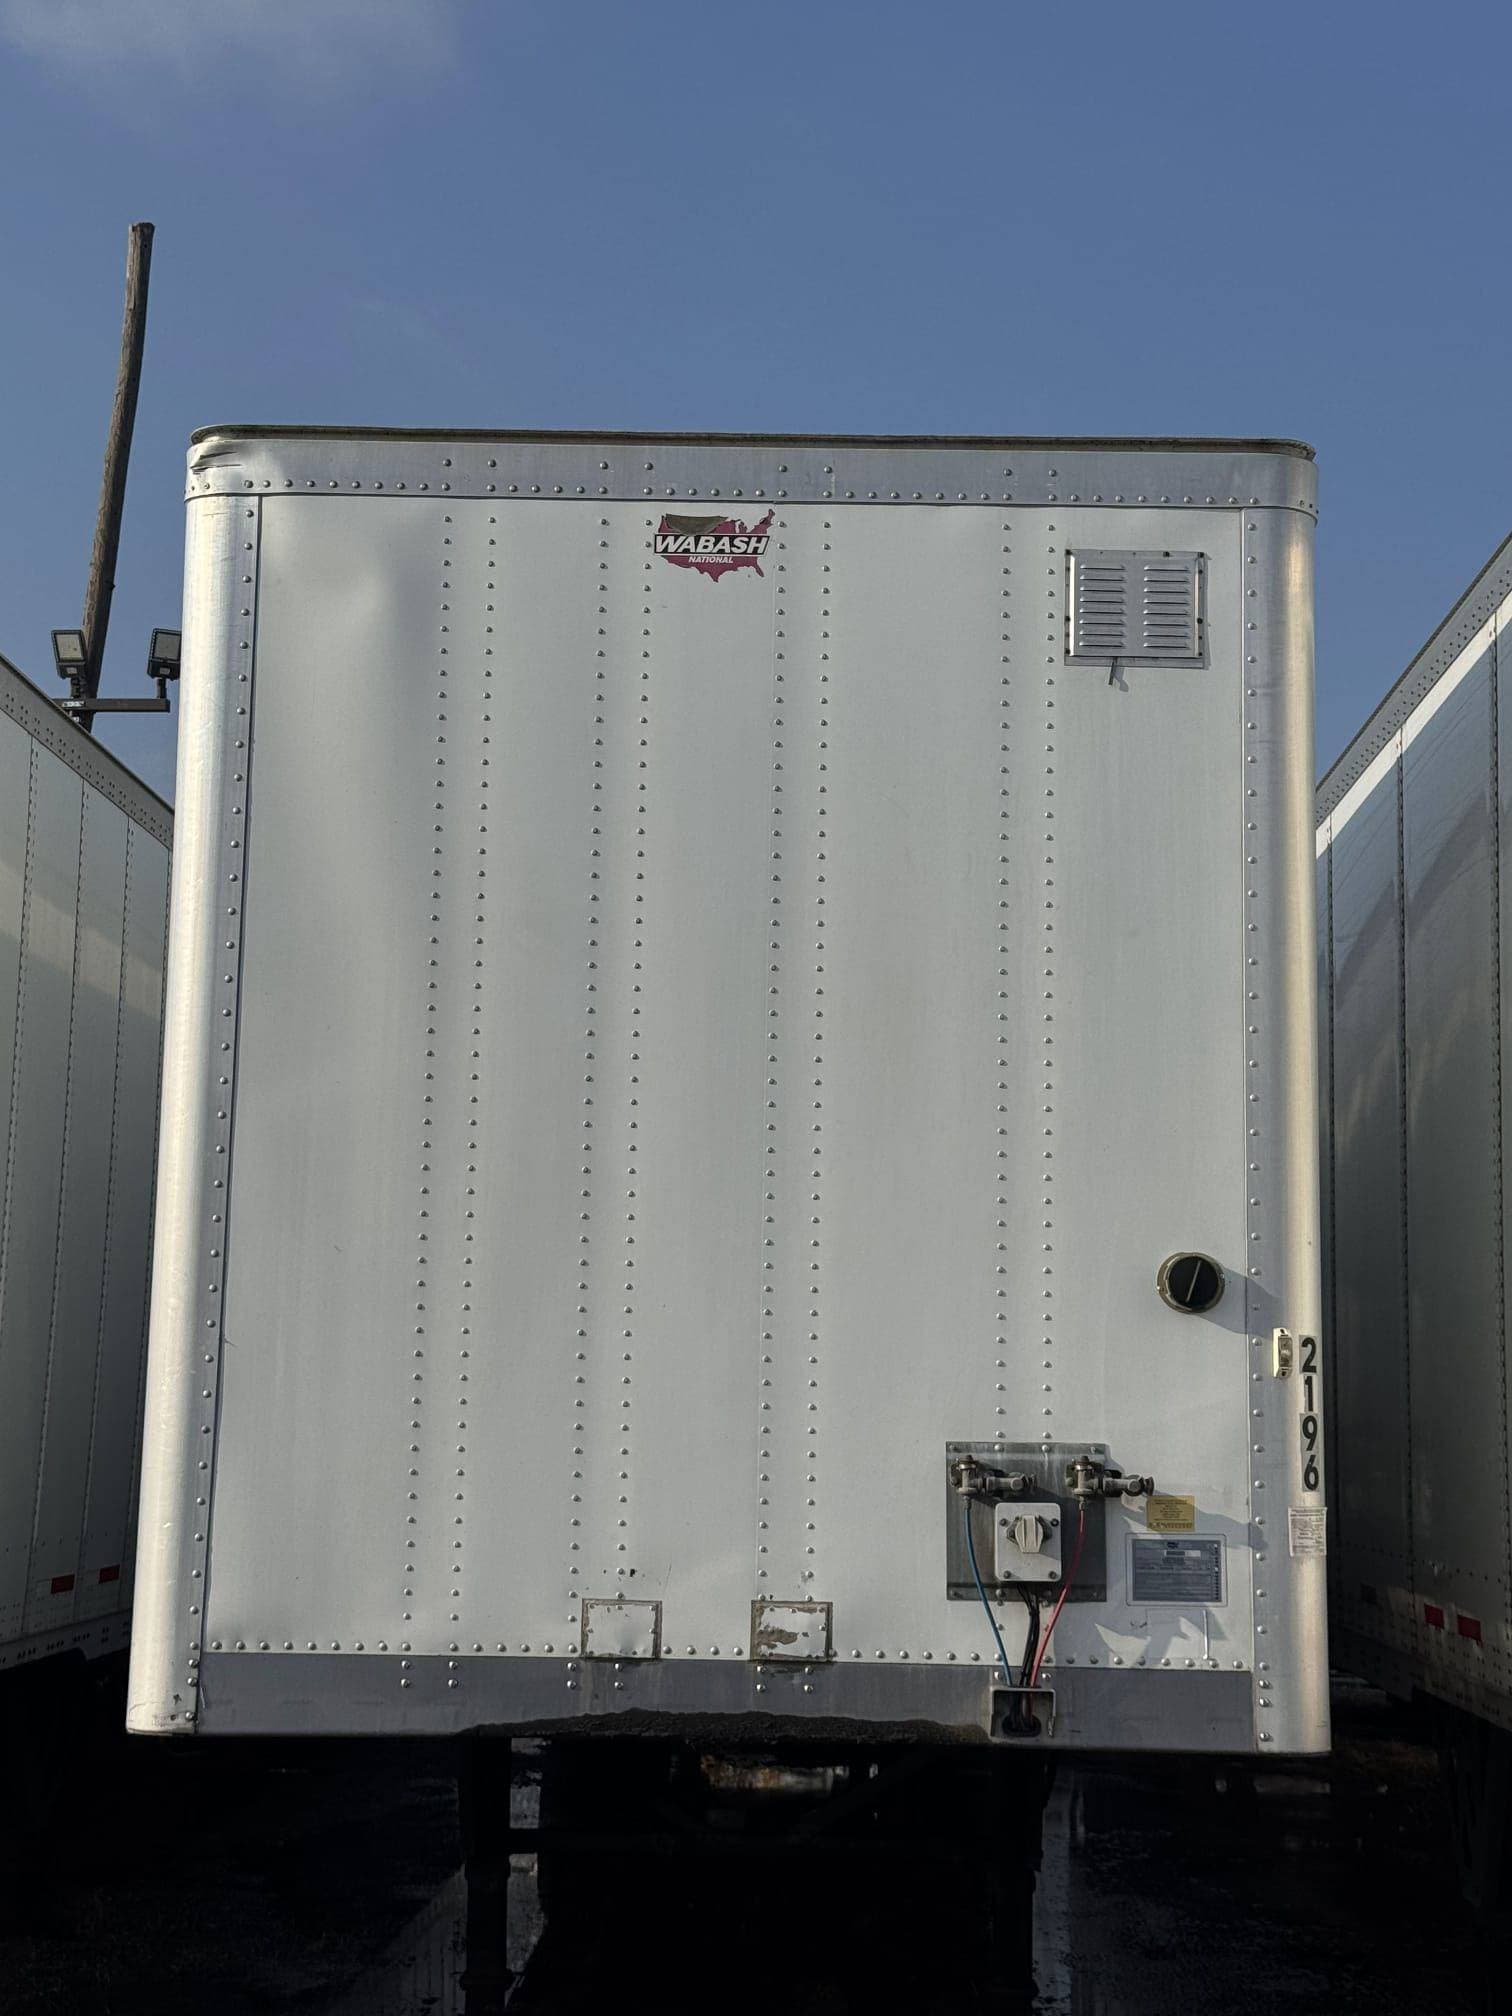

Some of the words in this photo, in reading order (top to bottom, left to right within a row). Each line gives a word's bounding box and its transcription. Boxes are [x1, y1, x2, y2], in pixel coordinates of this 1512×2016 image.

[655, 535, 768, 554] WABASH
[688, 556, 734, 564] NATIONAL
[1301, 1337, 1319, 1491] 2196
